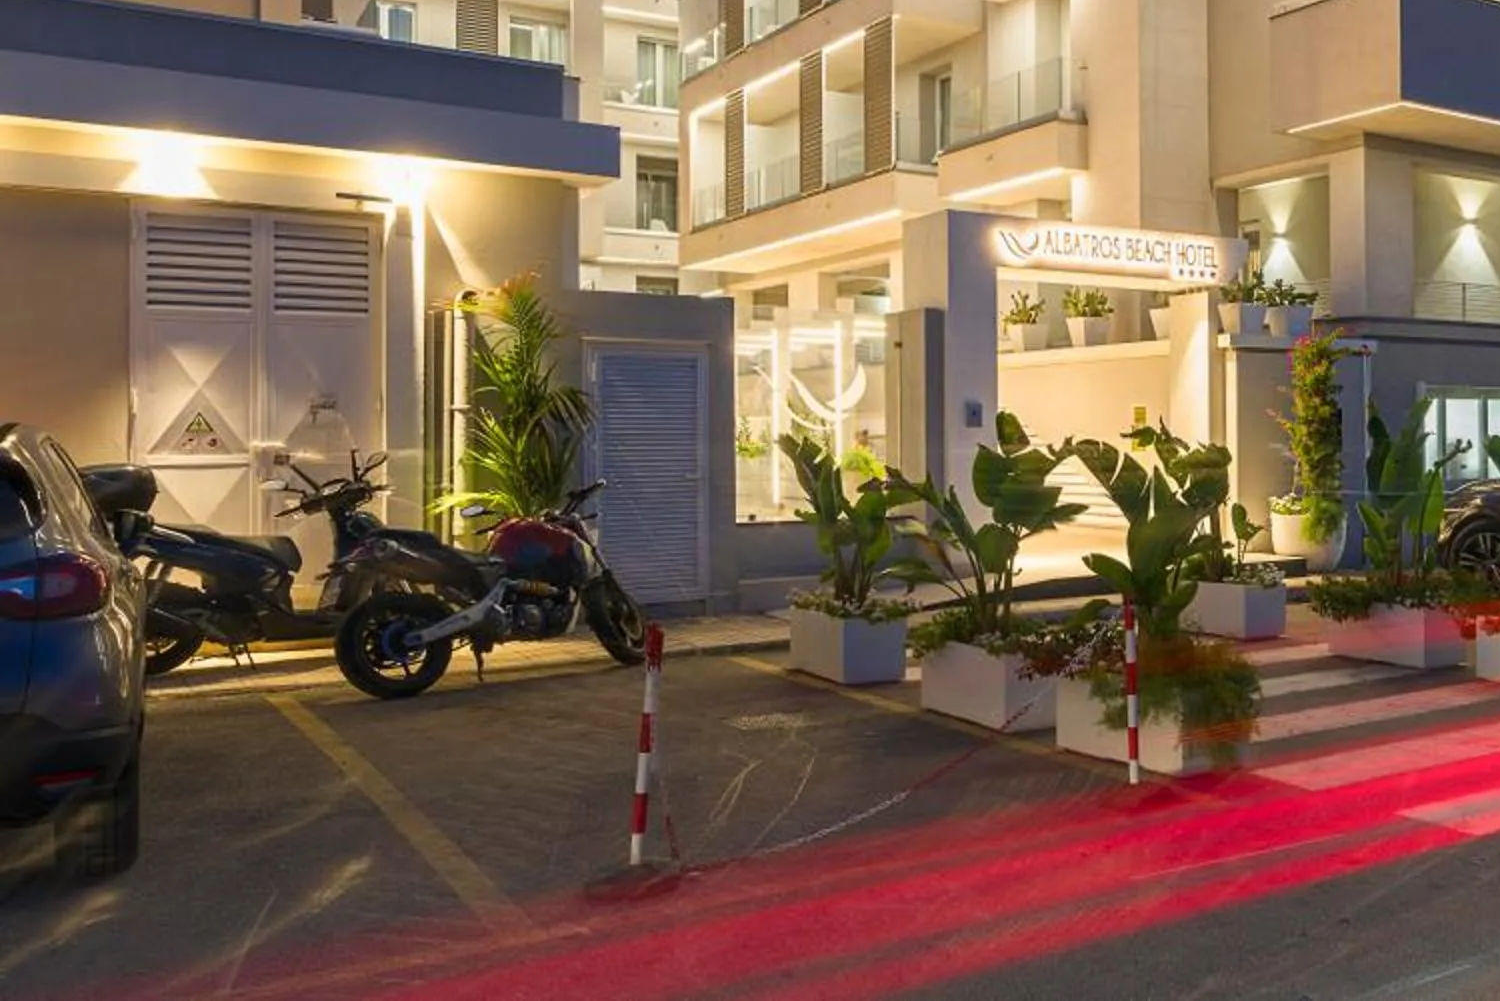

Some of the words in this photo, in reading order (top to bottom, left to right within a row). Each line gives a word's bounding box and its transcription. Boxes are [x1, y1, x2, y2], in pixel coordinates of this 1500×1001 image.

[1043, 230, 1121, 261] ALBATROS
[1126, 238, 1171, 264] BEACH
[1176, 243, 1218, 268] HOTEL
